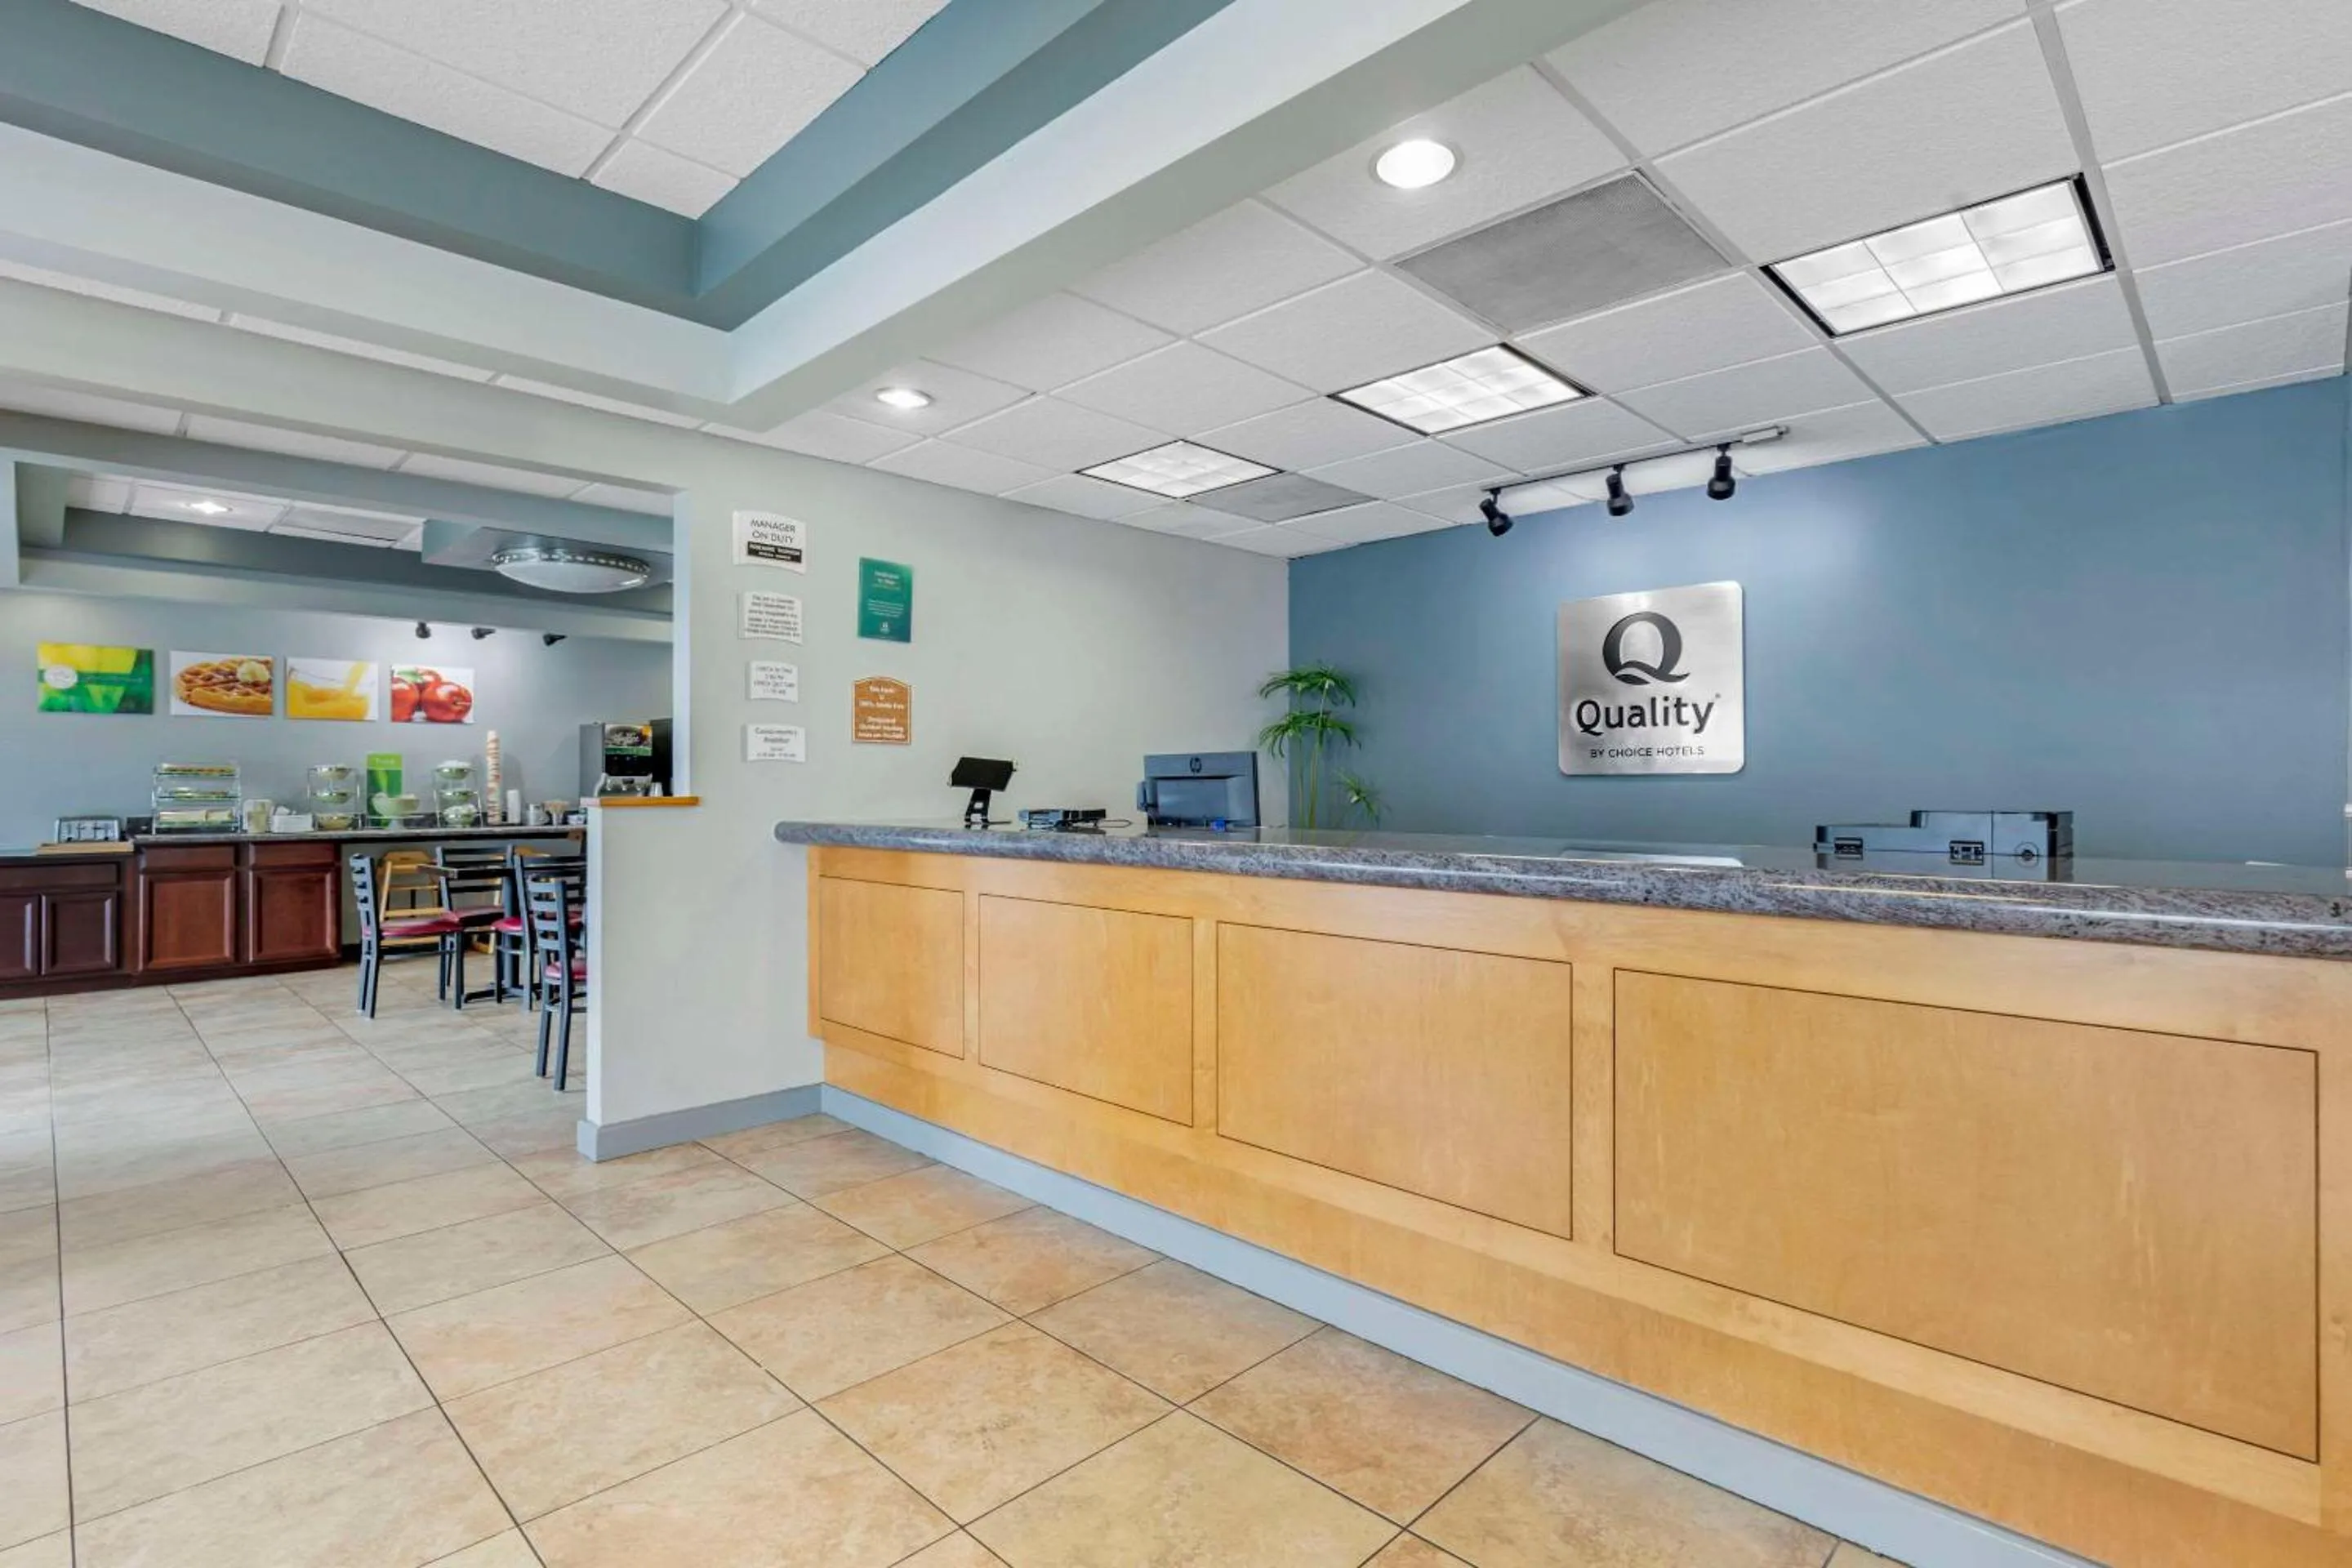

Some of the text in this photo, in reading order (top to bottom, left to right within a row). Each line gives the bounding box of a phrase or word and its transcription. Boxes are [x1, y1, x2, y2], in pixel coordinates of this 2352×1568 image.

[750, 519, 796, 534] MANAGER
[751, 530, 795, 544] ON DUTY
[1602, 611, 1690, 685] Q
[1576, 695, 1715, 737] Quality
[1590, 745, 1705, 758] BY CHOICE HOTELS
